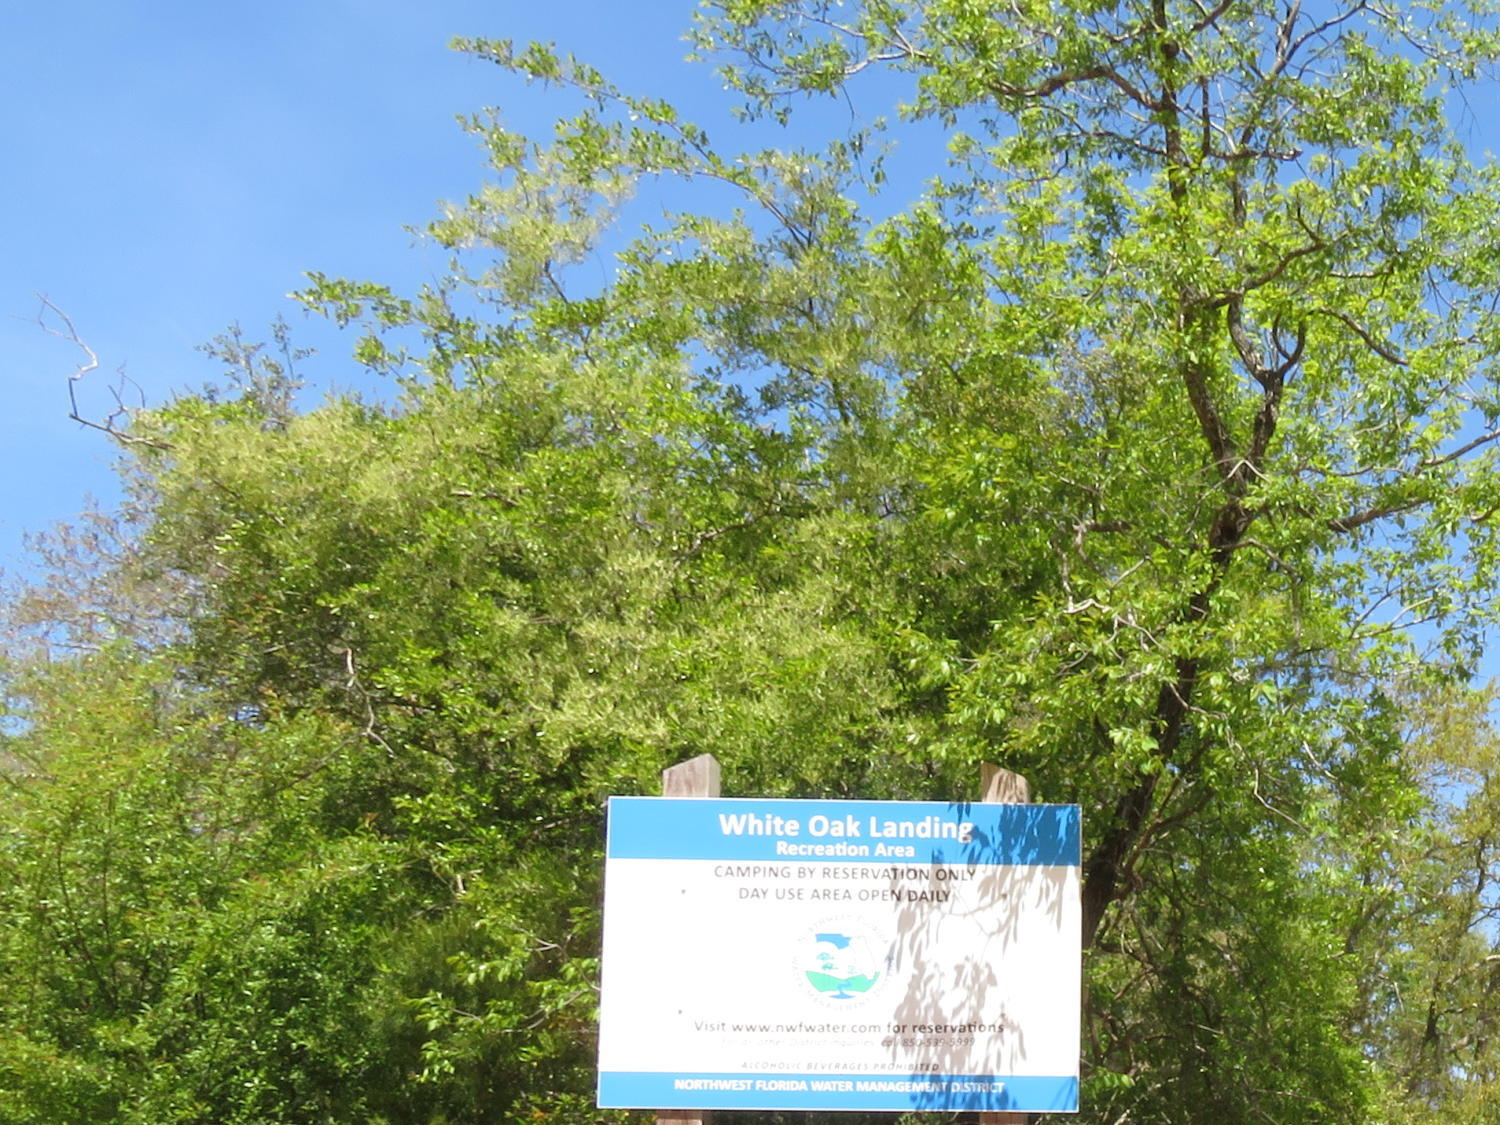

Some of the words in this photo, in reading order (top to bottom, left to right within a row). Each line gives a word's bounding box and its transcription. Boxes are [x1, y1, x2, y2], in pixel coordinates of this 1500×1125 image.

[719, 814, 799, 836] White
[809, 815, 860, 837] Oak
[870, 817, 973, 842] Landing
[776, 841, 871, 856] Recreation
[875, 843, 915, 857] Area
[714, 865, 791, 880] CAMPING
[797, 866, 816, 880] BY
[822, 867, 929, 881] RESERVATION
[936, 868, 976, 882] ONLY
[739, 887, 768, 900] DAY
[775, 887, 803, 901] USE
[810, 888, 851, 901] AREA
[858, 888, 901, 901] OPEN
[908, 889, 950, 902] DAILY
[695, 1020, 726, 1033] Visit
[731, 1021, 881, 1034] www.nwfwater.com
[885, 1021, 907, 1034] for
[912, 1022, 1004, 1034] reservations
[873, 1063, 940, 1072] PROHIBITED
[674, 1079, 753, 1091] NORTHWEST
[756, 1079, 807, 1091] FLORIDA
[811, 1080, 854, 1092] WATER
[856, 1080, 947, 1093] MANAGEMENT
[951, 1081, 1005, 1093] DISTRICT
